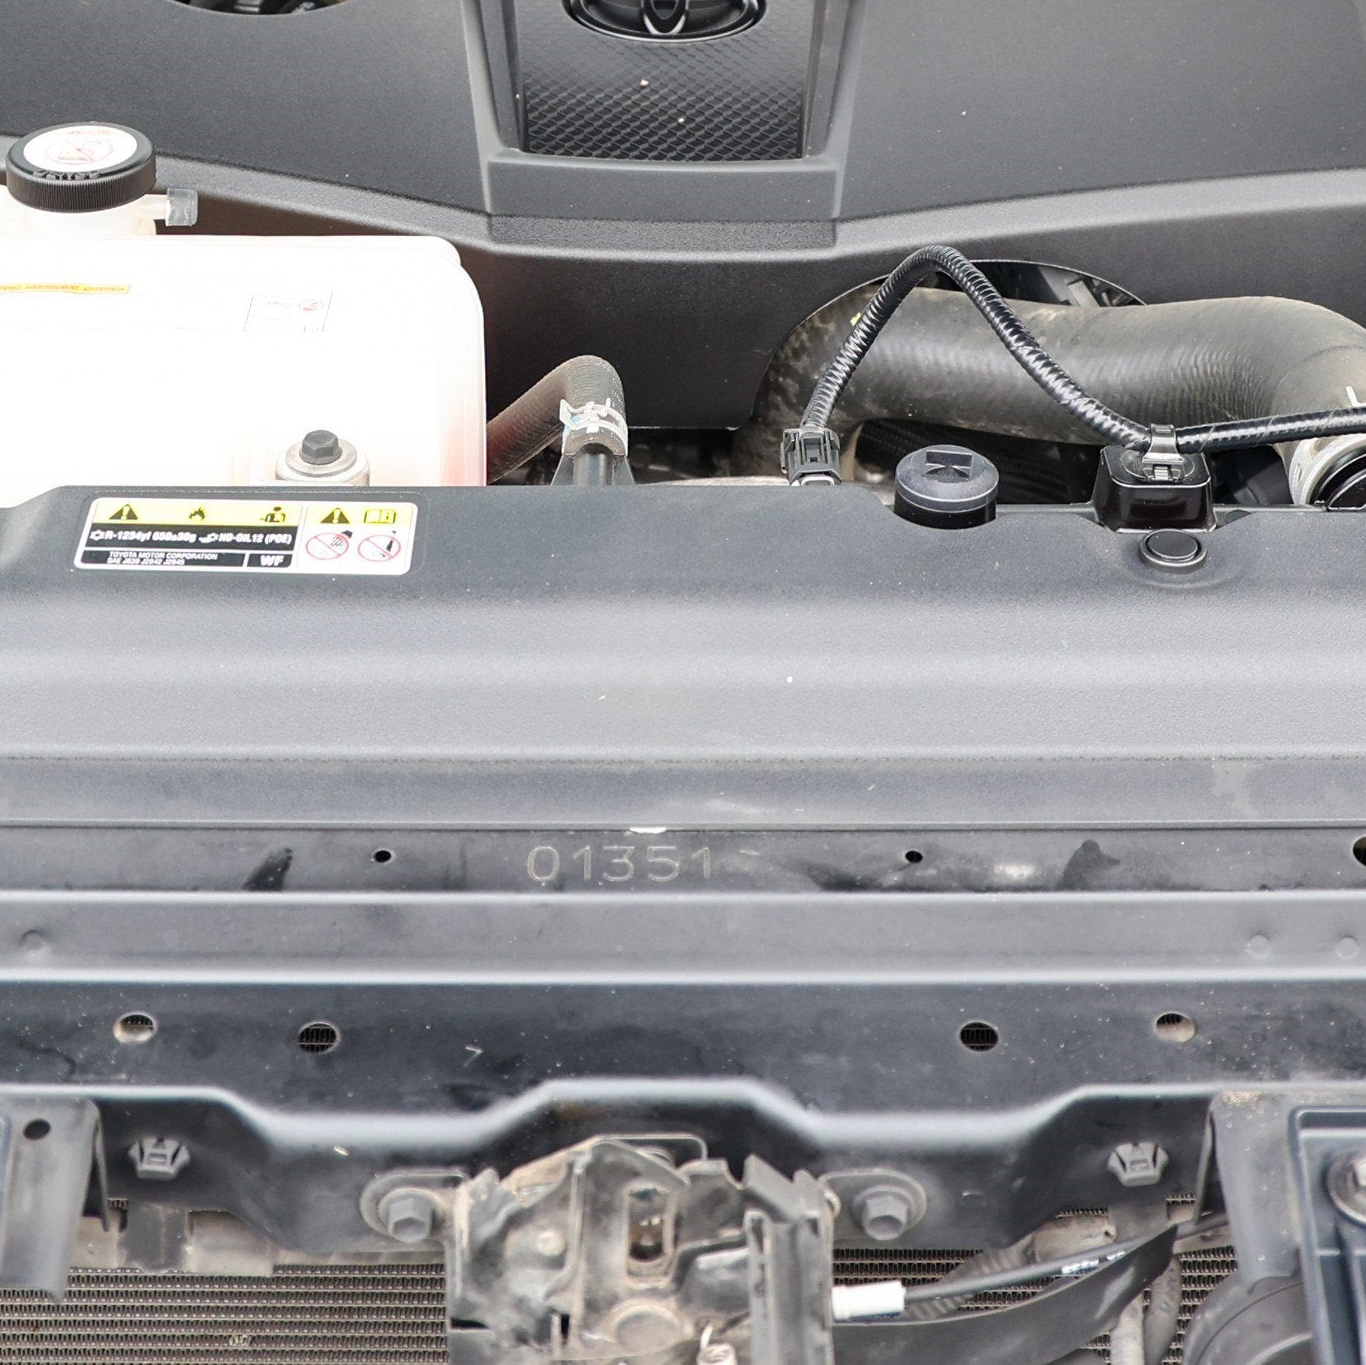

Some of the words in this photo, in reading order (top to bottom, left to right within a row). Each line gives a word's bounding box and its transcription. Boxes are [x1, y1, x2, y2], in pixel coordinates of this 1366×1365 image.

[166, 552, 218, 560] CORPORATION
[260, 555, 285, 566] WF
[526, 845, 712, 883] 01351
